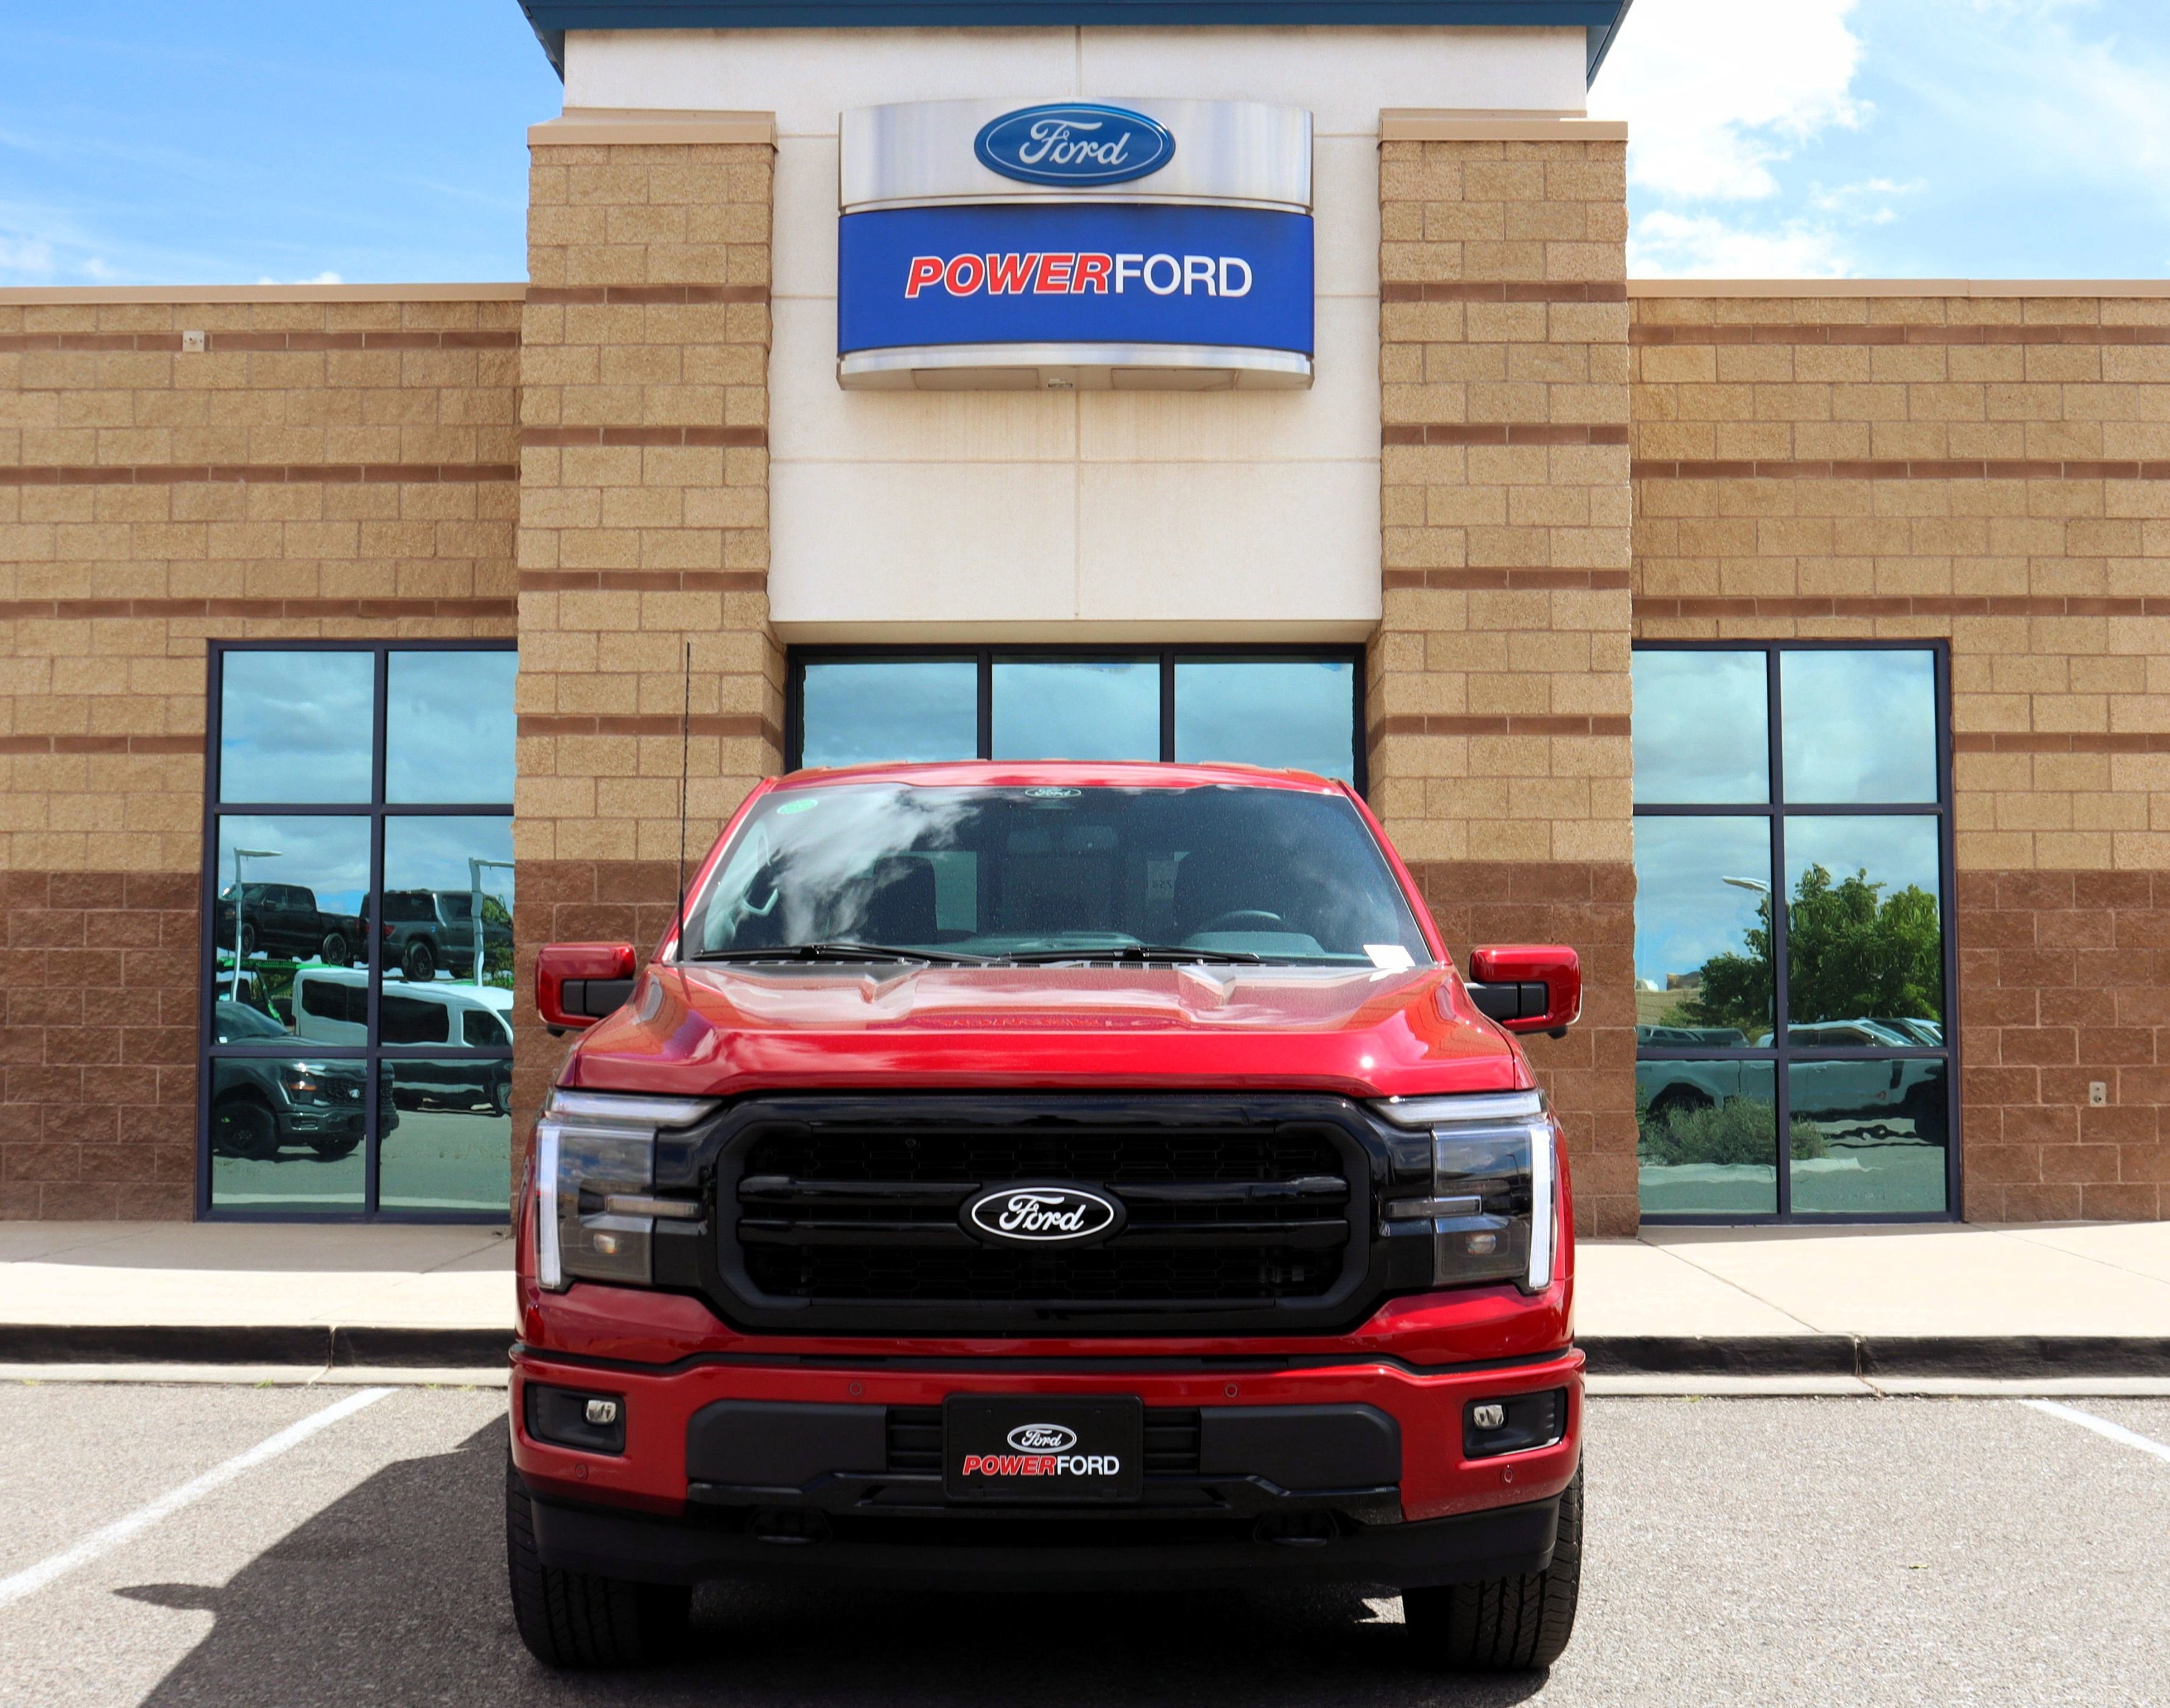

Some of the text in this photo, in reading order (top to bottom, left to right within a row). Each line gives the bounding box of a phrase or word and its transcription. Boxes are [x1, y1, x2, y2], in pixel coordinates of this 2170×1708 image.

[1019, 119, 1131, 164] Ford
[1034, 787, 1072, 796] Ford
[999, 1195, 1086, 1231] Ford
[1021, 1429, 1062, 1447] Ford
